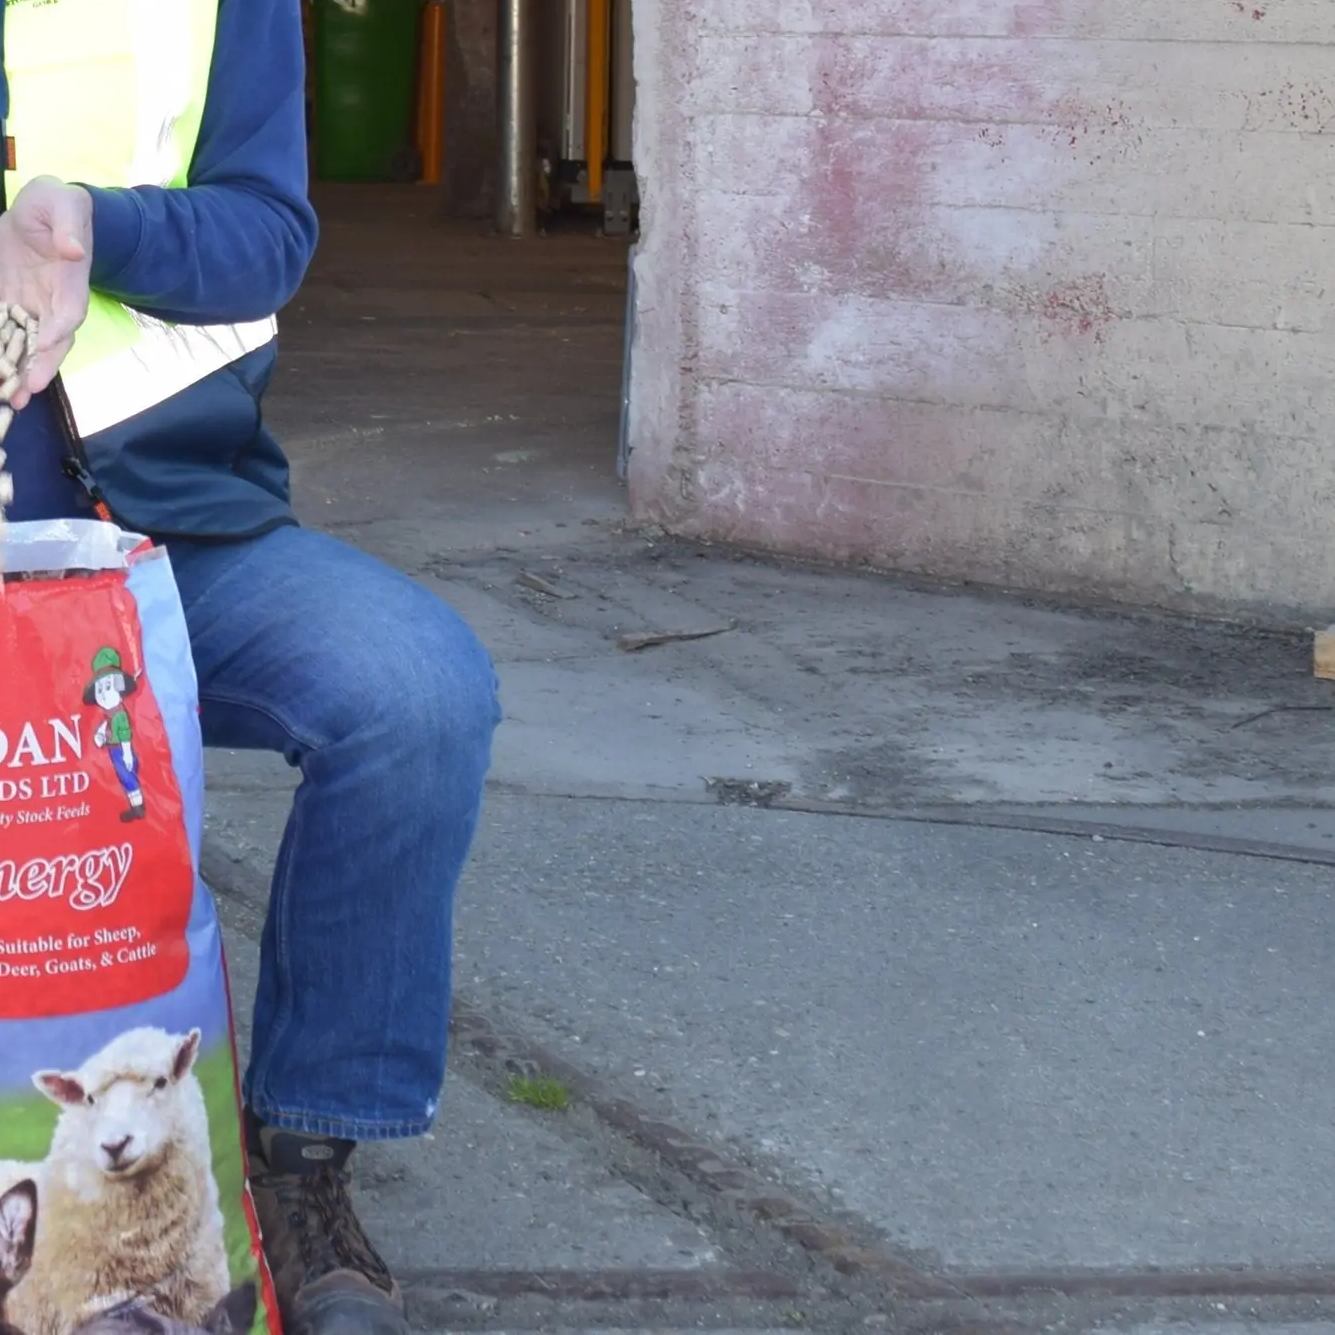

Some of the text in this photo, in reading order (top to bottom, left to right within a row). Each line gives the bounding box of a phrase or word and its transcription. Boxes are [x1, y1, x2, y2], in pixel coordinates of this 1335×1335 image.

[40, 770, 90, 799] LTD
[16, 808, 54, 825] Stock
[56, 802, 91, 821] Feeds
[66, 931, 91, 950] for
[93, 924, 142, 947] Sheep,
[44, 955, 97, 976] Goats,
[99, 952, 115, 968] &
[116, 941, 158, 965] Cattle
